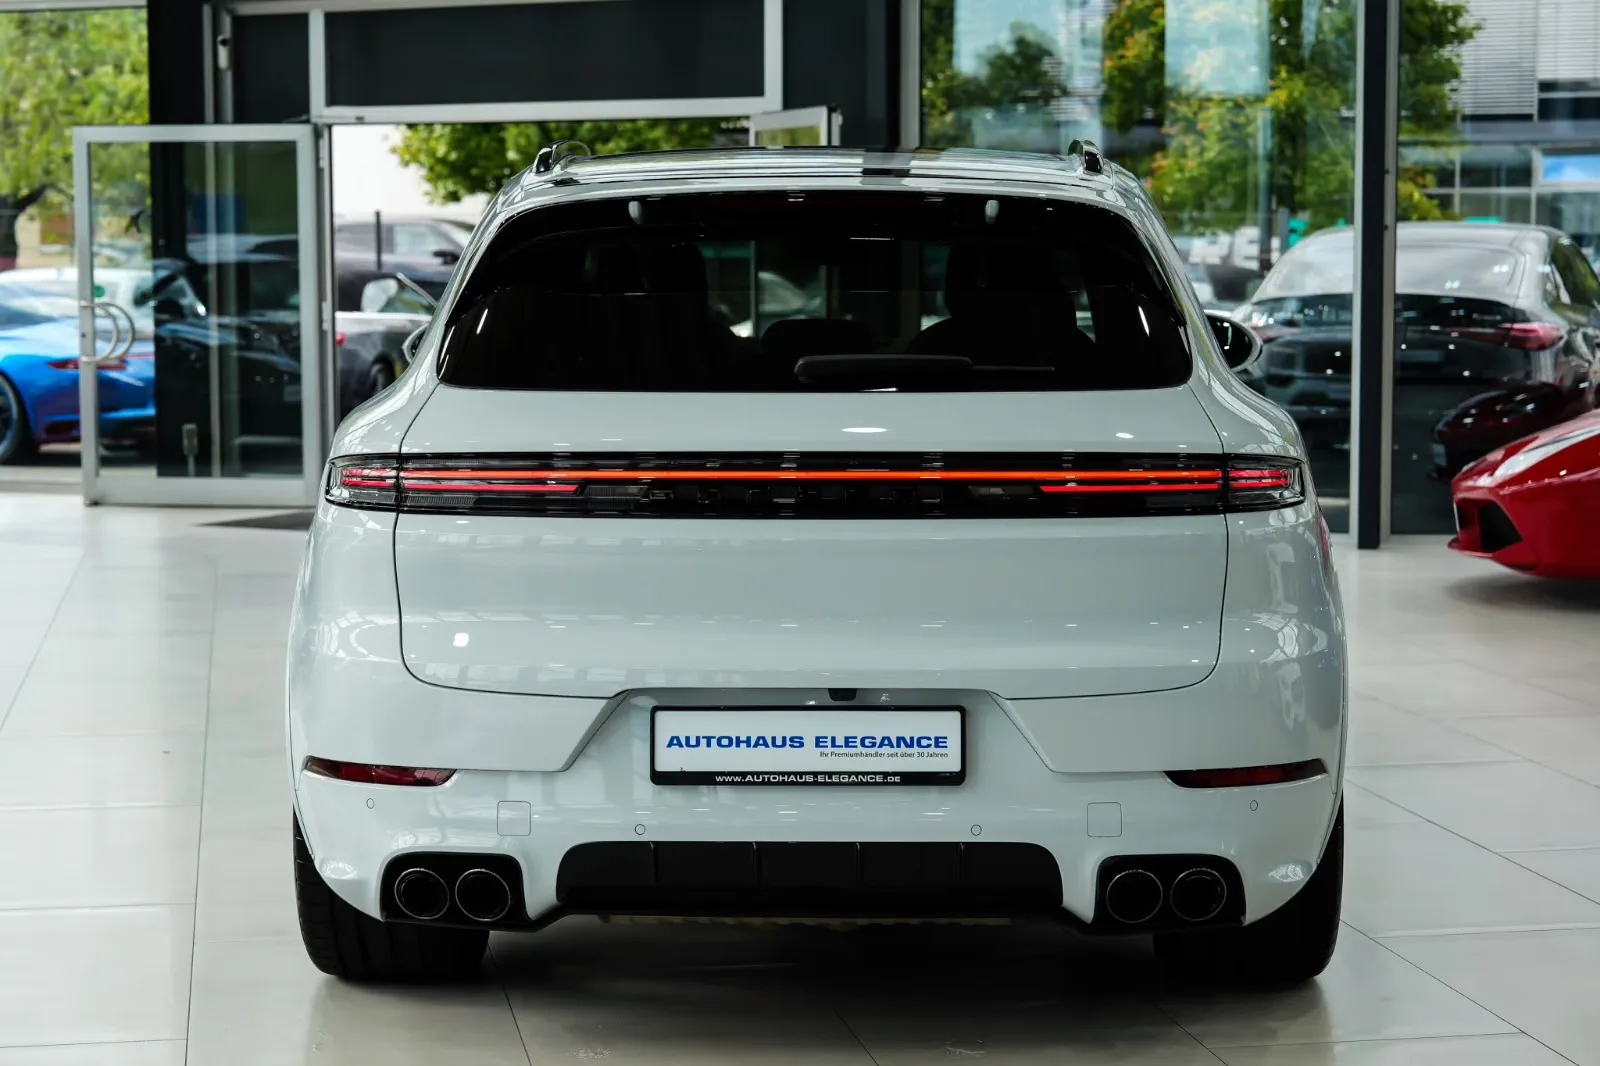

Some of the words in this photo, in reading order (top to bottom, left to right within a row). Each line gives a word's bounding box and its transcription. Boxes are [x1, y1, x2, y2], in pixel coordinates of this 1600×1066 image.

[666, 736, 805, 748] AUTOHAUS
[814, 736, 948, 748] ELEGANCE
[900, 750, 915, 758] über
[926, 751, 948, 759] Jahren
